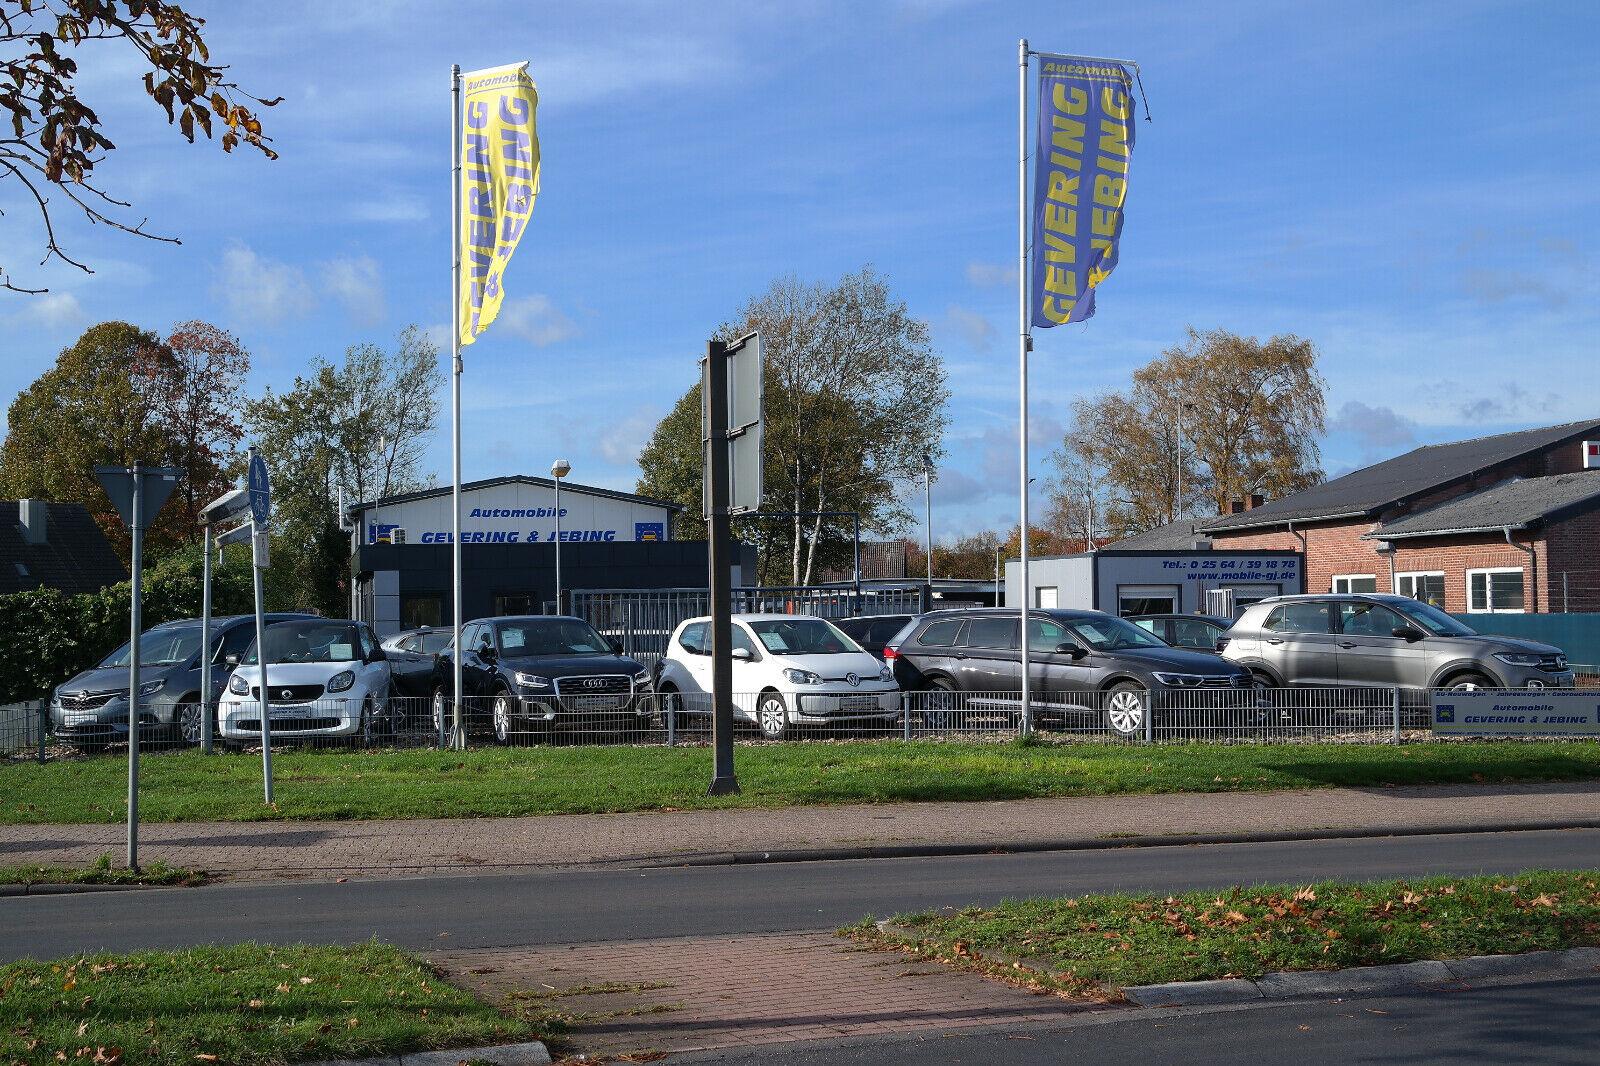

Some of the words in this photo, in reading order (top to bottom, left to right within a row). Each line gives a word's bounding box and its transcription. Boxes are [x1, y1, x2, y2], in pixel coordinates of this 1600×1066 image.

[1043, 62, 1124, 77] Automob
[467, 73, 533, 91] Automob
[1090, 86, 1132, 258] JEBING
[1042, 82, 1089, 324] GEVERING
[469, 507, 568, 518] Automobile
[526, 530, 539, 543] &
[546, 530, 616, 542] JEBING
[1162, 560, 1187, 569] Tel.:
[1190, 560, 1199, 569] 0
[1201, 560, 1217, 569] 25
[1219, 560, 1236, 569] 64
[1238, 560, 1244, 569] /
[1246, 560, 1262, 569] 39
[1265, 560, 1278, 569] 18
[1281, 560, 1296, 569] 78
[1187, 571, 1296, 581] www.mobile-gj.de
[1464, 715, 1526, 724] GEVERING
[1529, 715, 1538, 724] &
[1542, 715, 1588, 724] JEBING
